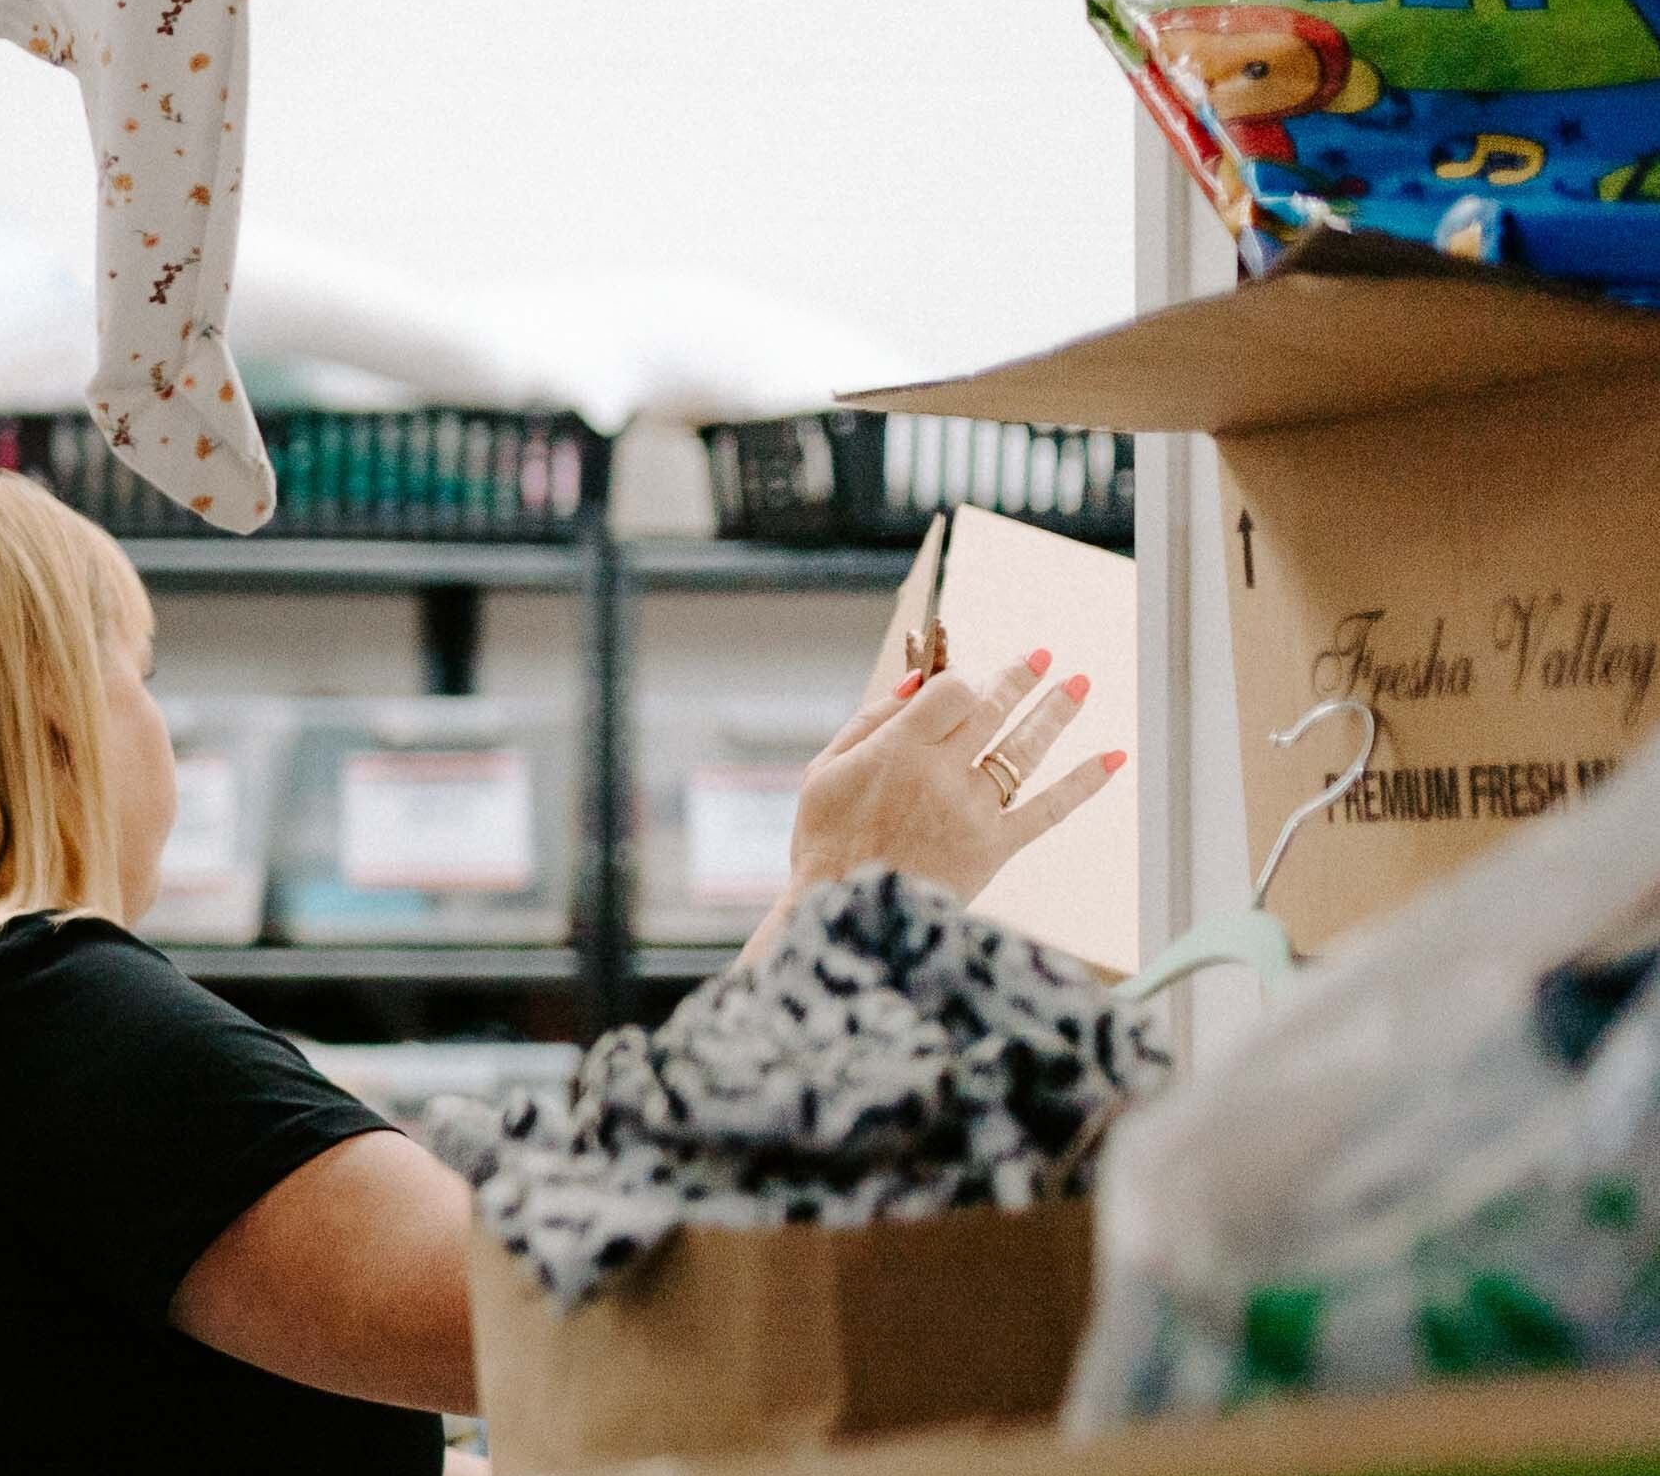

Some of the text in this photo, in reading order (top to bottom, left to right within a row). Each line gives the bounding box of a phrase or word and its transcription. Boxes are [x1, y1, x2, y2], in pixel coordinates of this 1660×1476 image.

[1493, 589, 1658, 727] Valley
[1324, 766, 1460, 822] PREMIUM
[1468, 761, 1567, 818] FRESH
